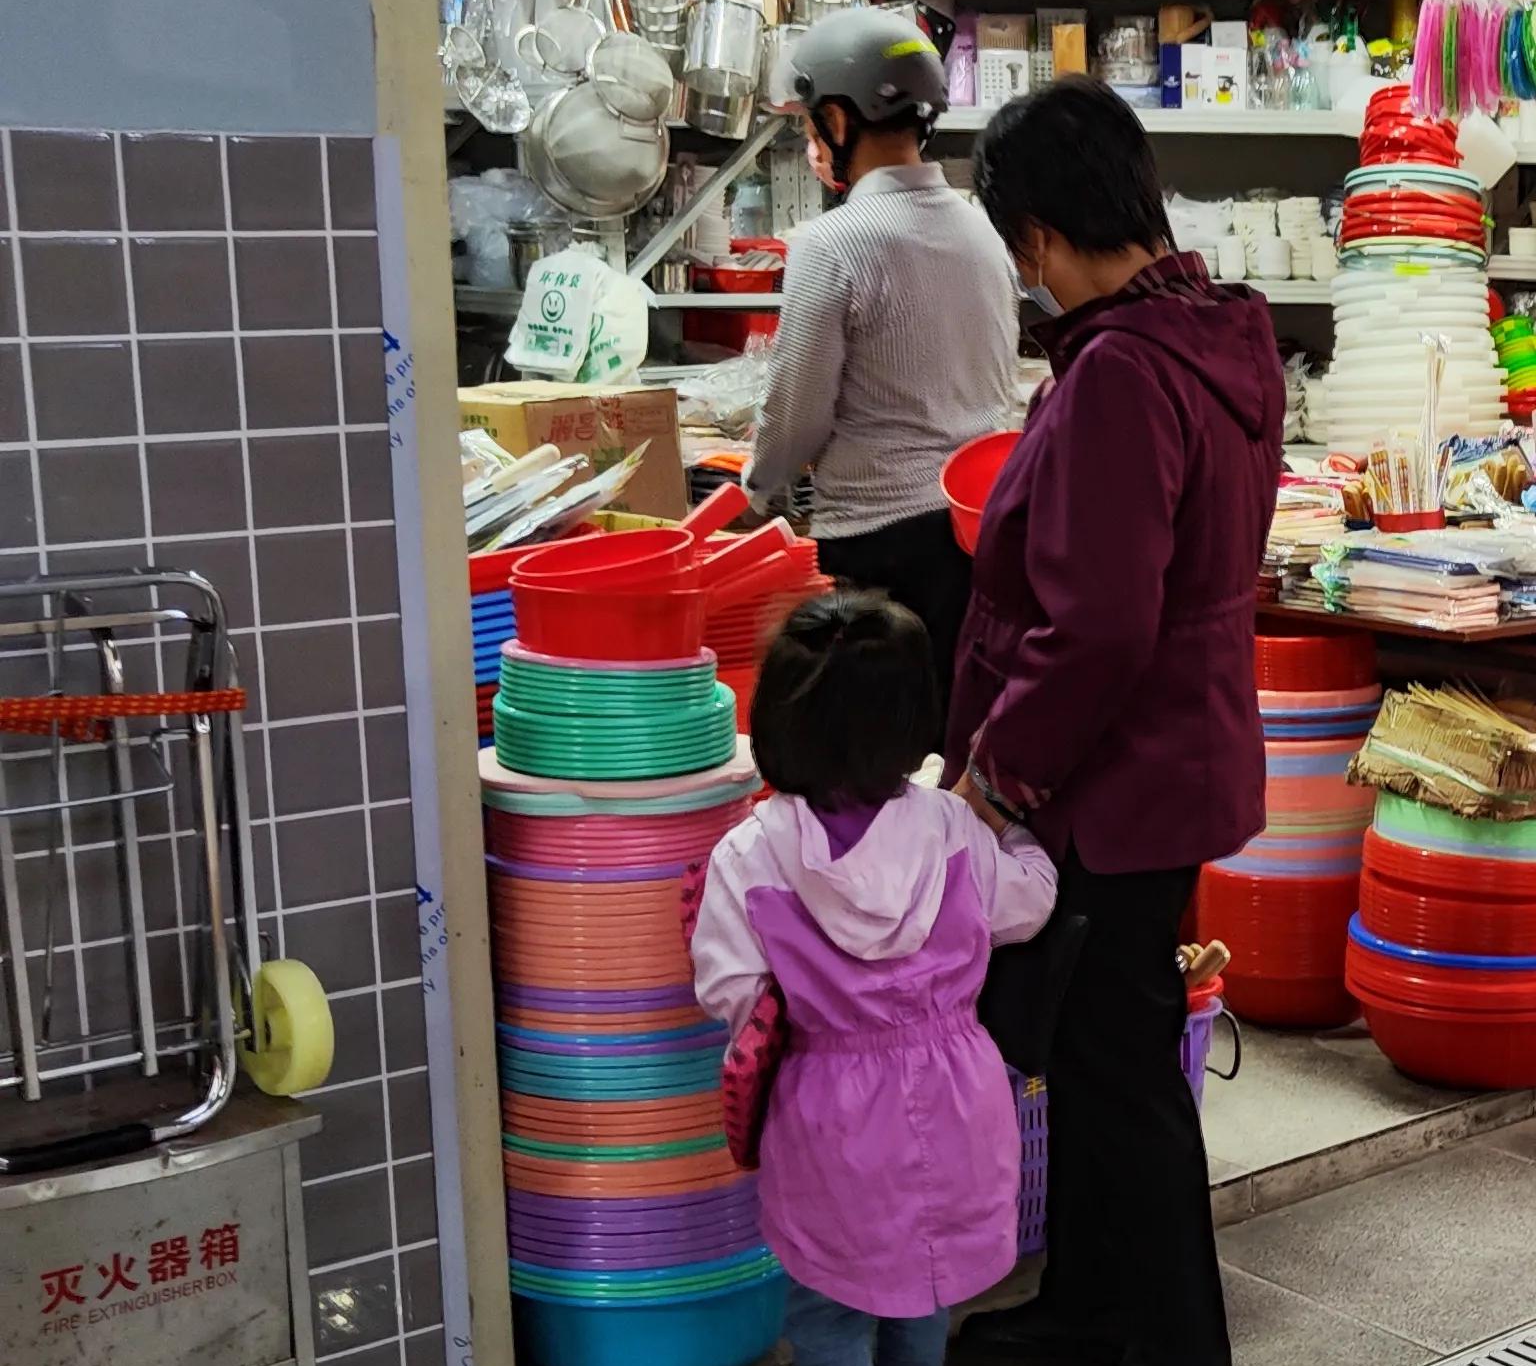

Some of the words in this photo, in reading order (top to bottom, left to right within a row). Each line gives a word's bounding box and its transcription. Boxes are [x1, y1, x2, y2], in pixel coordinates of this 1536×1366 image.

[40, 1222, 241, 1314] 灭火器箱
[41, 1313, 81, 1336] FIRE
[88, 1278, 206, 1324] EXTINGUISHER
[204, 1269, 239, 1291] BOX
